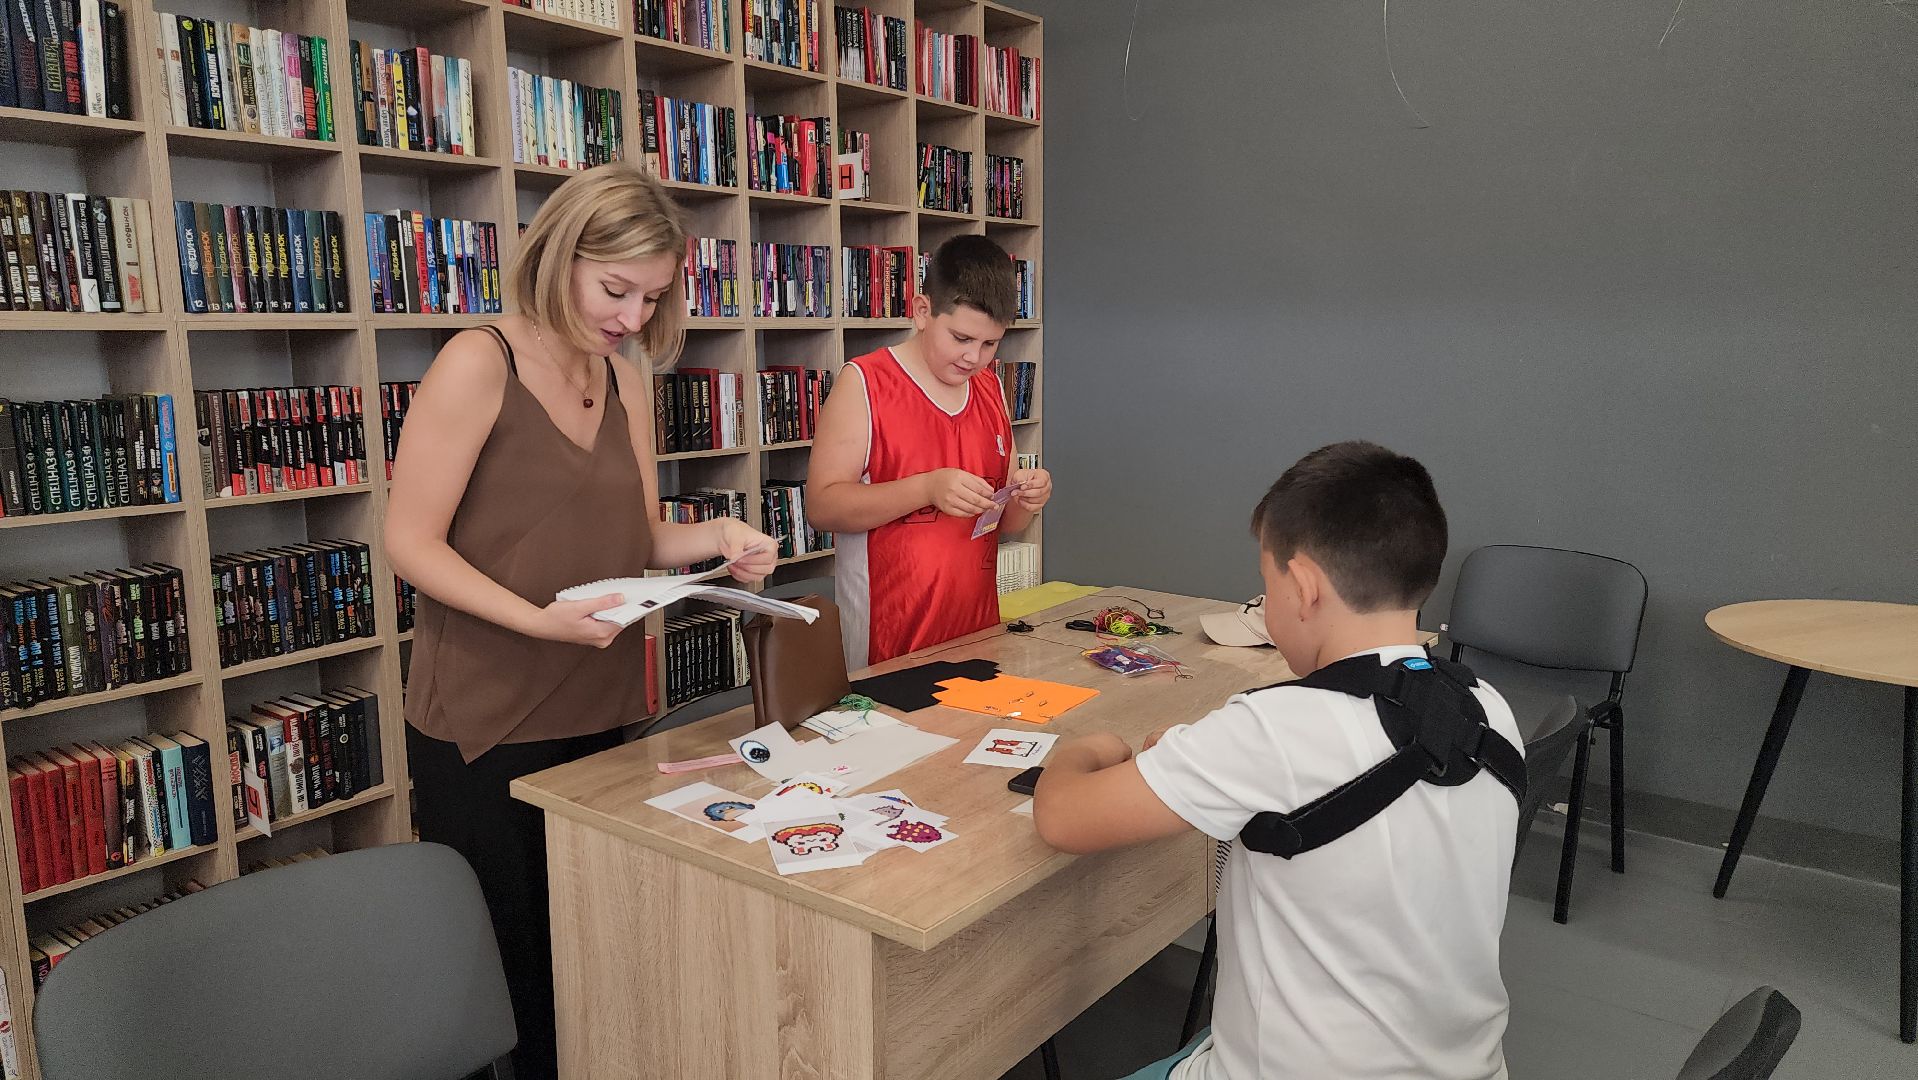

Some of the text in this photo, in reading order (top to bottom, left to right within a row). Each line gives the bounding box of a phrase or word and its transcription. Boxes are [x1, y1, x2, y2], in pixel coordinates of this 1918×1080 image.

[78, 202, 94, 276] Виктория Платова
[185, 228, 199, 275] ПОЕДИНОК
[200, 231, 214, 278] ПОЕДИНОК
[215, 231, 228, 278] ПОЕДИНОК
[230, 232, 243, 278] ПОЕДИНОК
[246, 231, 260, 277] ПОЕДИНОК
[261, 232, 275, 277] ПОЕДИНОК
[276, 233, 289, 278] ПОЕДИНОК
[293, 233, 305, 278] ПОЕДИНОК
[311, 236, 323, 280] ПОЕДИНОК
[331, 234, 342, 278] ПОЕДИНОК
[390, 240, 400, 280] ПОЕДИНОК
[27, 462, 41, 510] СПЕЦНАЗ
[46, 457, 62, 505] СПЕЦНАЗ
[66, 459, 81, 506] СПЕЦНАЗ
[83, 455, 98, 502] СПЕЦНАЗ
[104, 458, 116, 504] СПЕЦНАЗ
[117, 457, 130, 503] СПЕЦНАЗ
[264, 565, 273, 586] ВСЕХ
[19, 646, 29, 660] ВОР
[1, 671, 12, 697] СУХОВ
[290, 718, 299, 742] СМЕРТИ
[229, 751, 241, 784] МОСКВА
[312, 765, 321, 789] ЧАЙЛД
